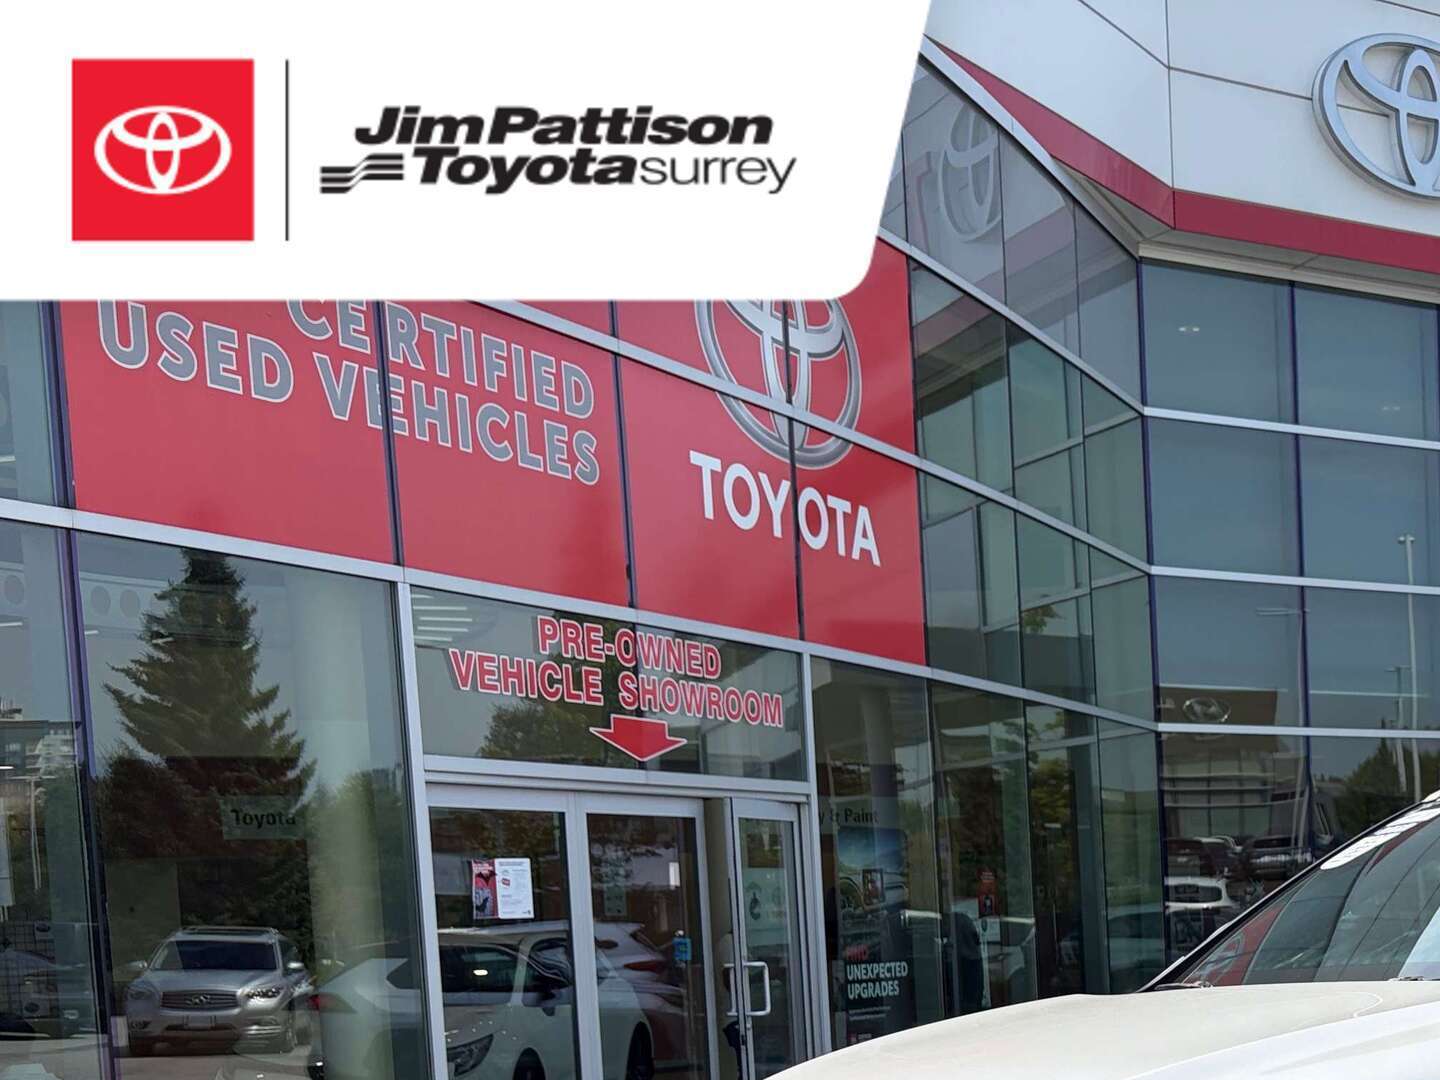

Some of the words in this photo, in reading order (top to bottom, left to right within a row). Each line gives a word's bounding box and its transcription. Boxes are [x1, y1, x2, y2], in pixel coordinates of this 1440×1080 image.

[98, 299, 294, 403] USED
[312, 351, 600, 485] VEHICLES
[286, 299, 594, 419] CERTIFIED
[689, 449, 881, 568] TOYOTA
[537, 614, 722, 681] PRE-OWNED
[449, 648, 604, 706] VEHICLE
[618, 672, 784, 728] SHOWROOM
[230, 808, 297, 829] Toyota
[846, 961, 909, 981] UNEXPECTED
[847, 980, 900, 1000] UPGRADES
